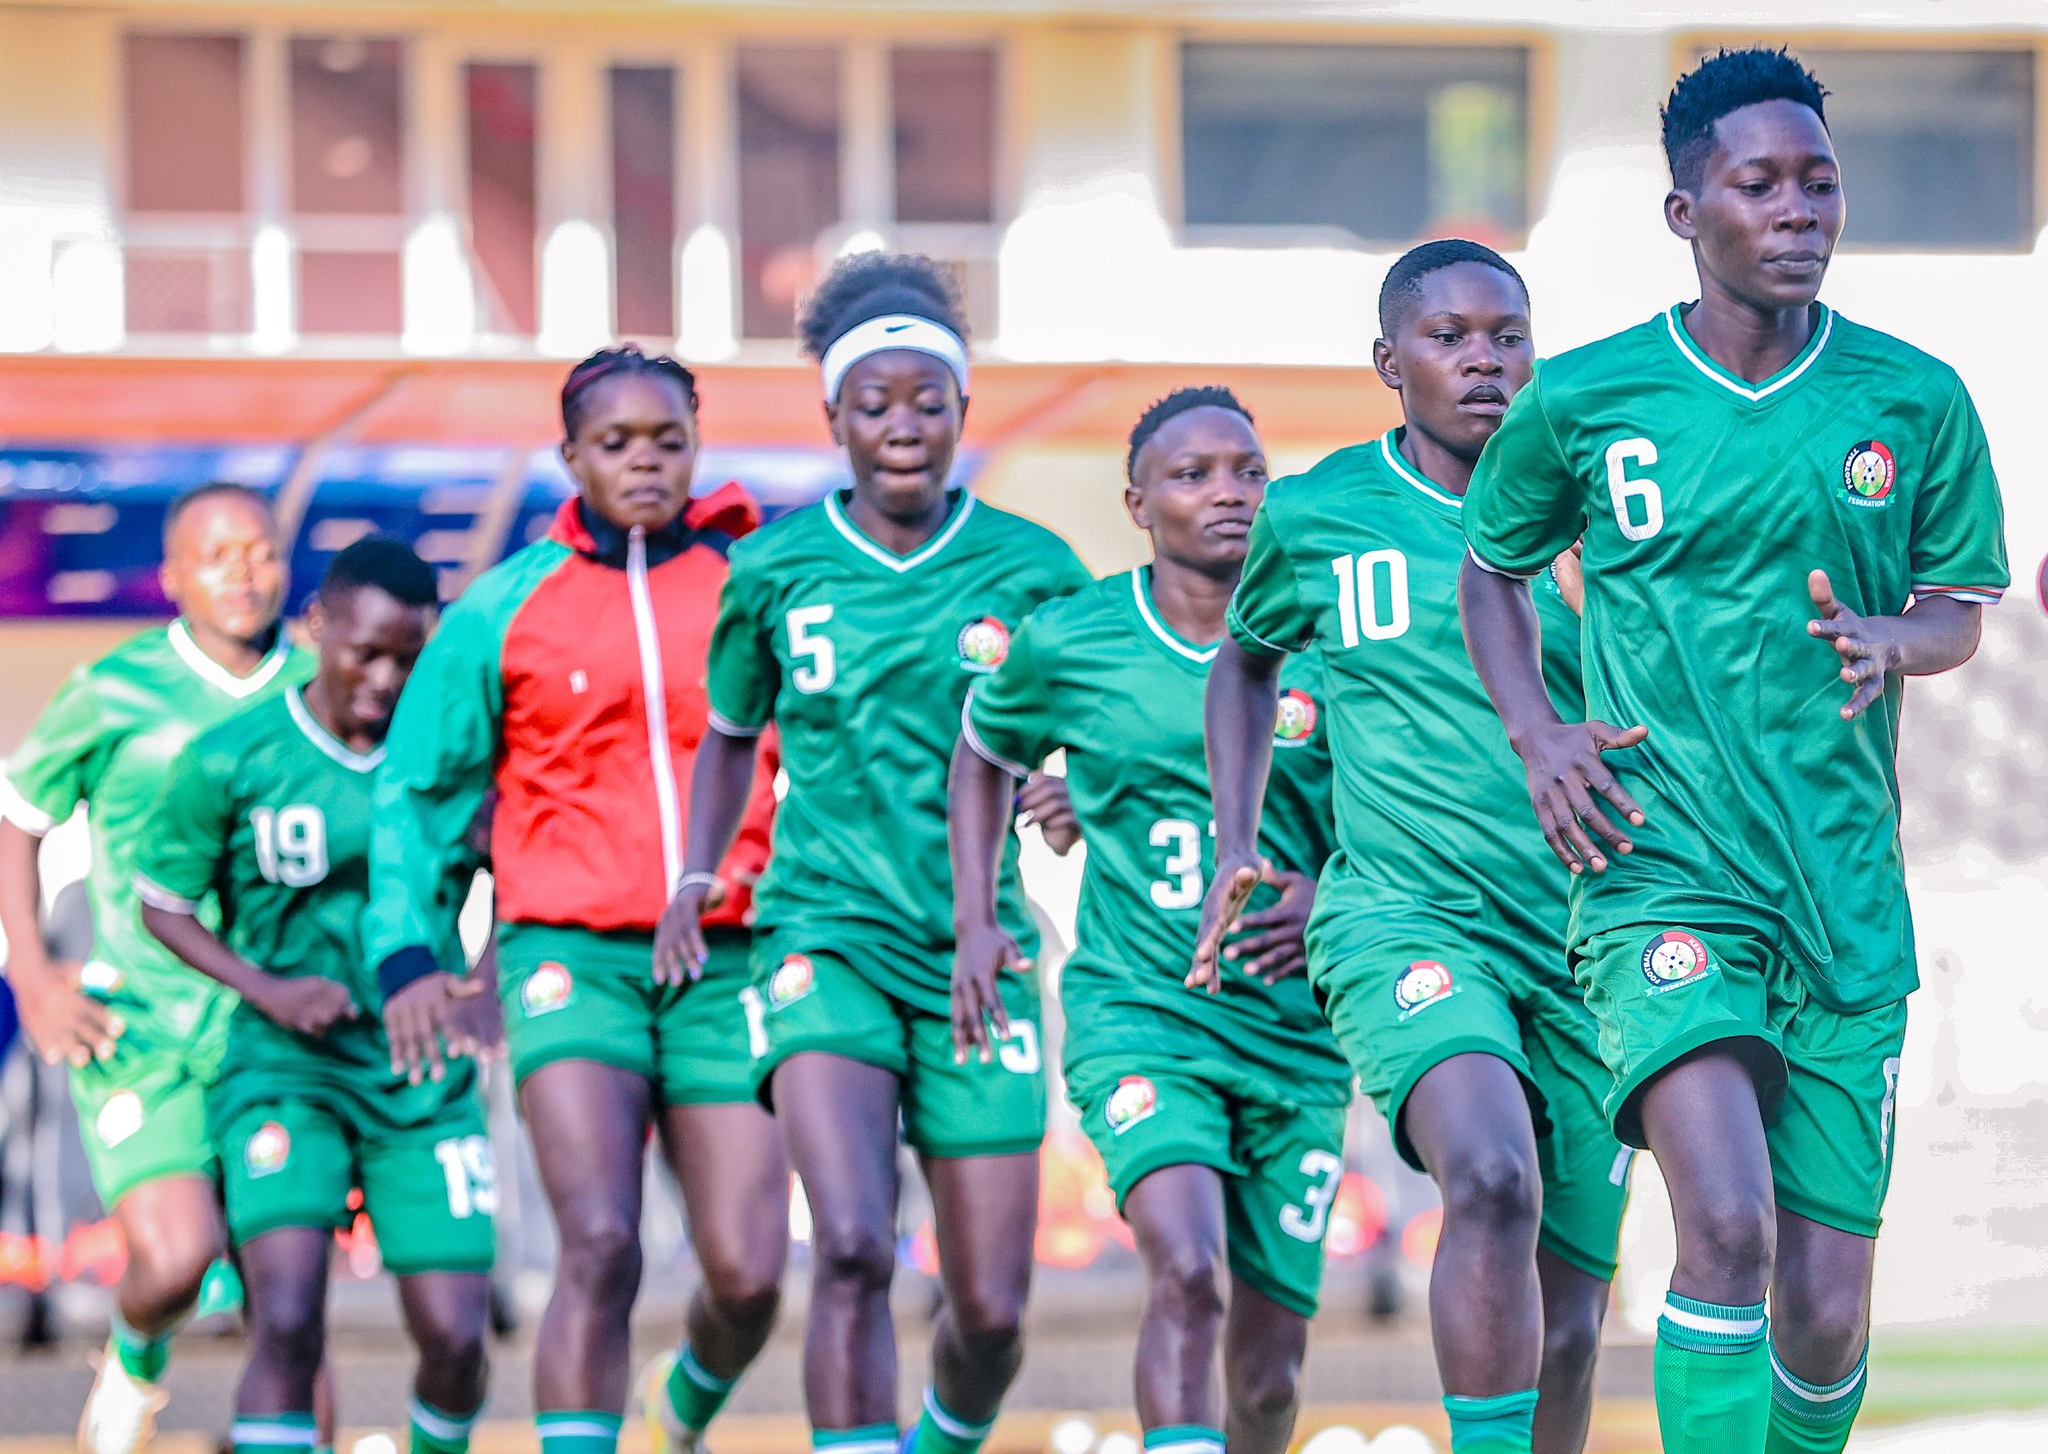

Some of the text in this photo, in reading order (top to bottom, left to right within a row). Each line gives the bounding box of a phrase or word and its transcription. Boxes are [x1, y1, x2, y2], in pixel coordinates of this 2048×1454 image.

[1605, 437, 1664, 541] 6
[1845, 448, 1860, 490] FOOTBALL
[1885, 458, 1894, 489] KENYA
[1847, 496, 1886, 508] FEDERATION
[1331, 548, 1411, 649] 10
[785, 604, 836, 694] 5
[249, 804, 329, 888] 19
[1149, 819, 1217, 910] 3
[1643, 948, 1661, 985] FOOTBALL
[1687, 938, 1705, 963] KENYA
[1659, 971, 1709, 993] FEDERATION
